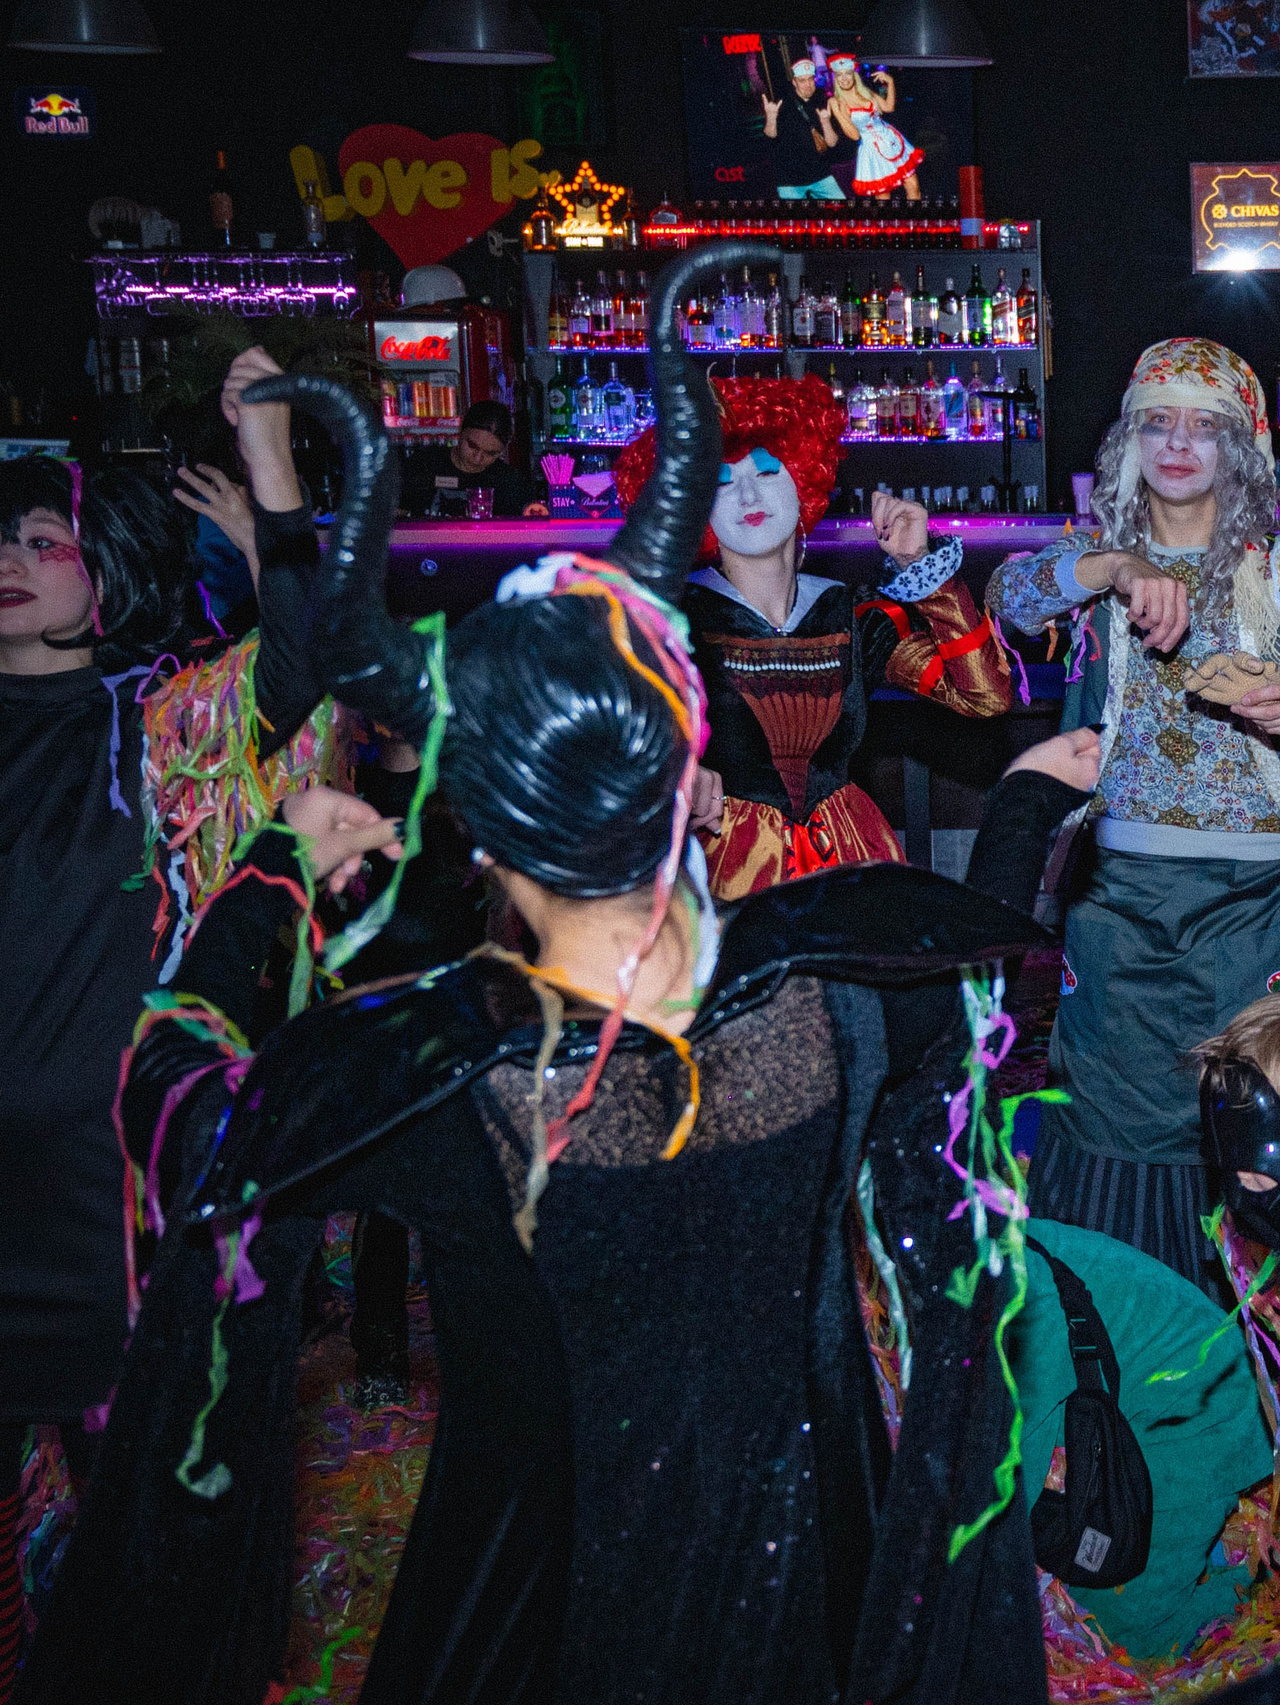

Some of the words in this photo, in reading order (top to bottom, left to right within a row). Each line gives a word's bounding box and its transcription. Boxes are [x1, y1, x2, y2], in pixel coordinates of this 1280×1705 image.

[25, 116, 57, 133] Red
[57, 116, 89, 133] Bull
[290, 145, 467, 222] Love
[1230, 204, 1280, 217] CHIVAS
[553, 498, 570, 507] STAY
